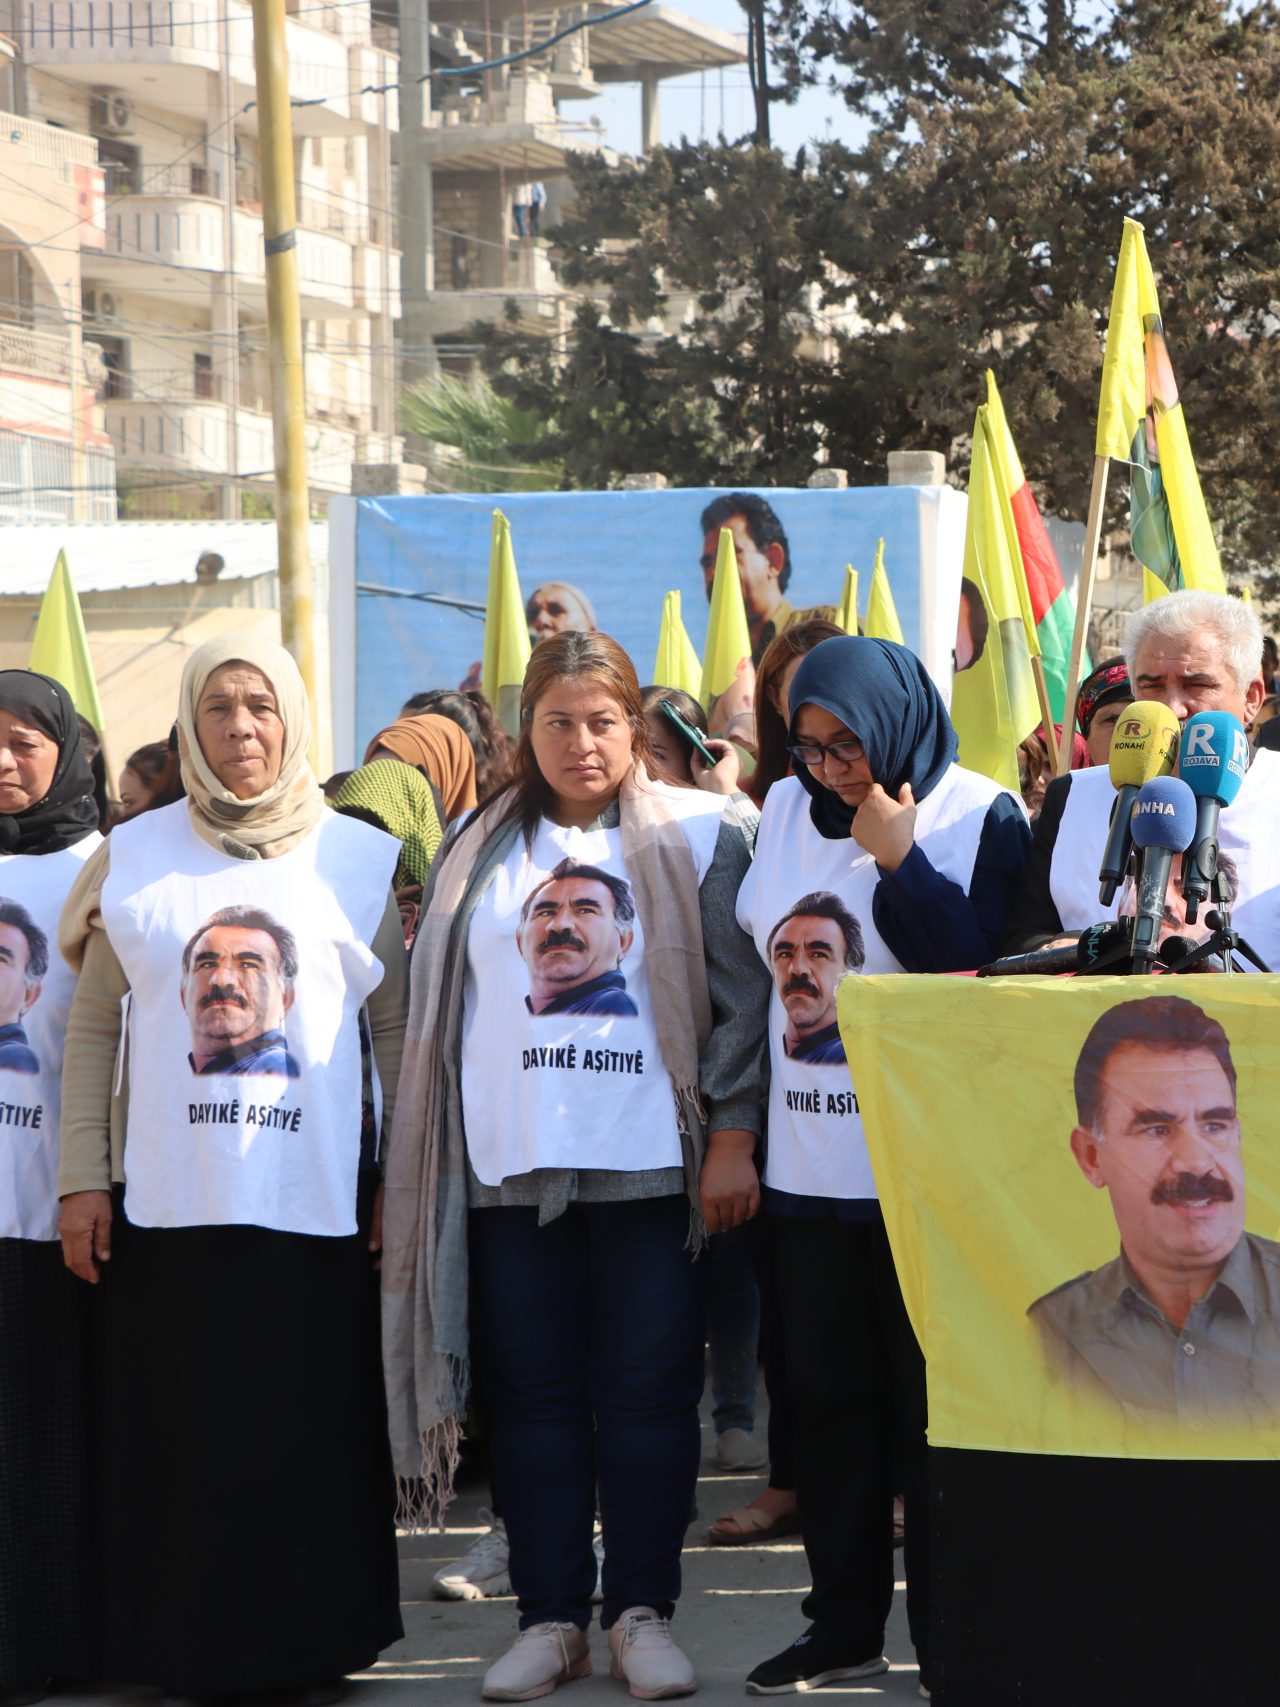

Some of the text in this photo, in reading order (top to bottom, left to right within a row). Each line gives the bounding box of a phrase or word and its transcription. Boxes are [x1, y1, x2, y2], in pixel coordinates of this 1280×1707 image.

[1187, 723, 1216, 755] R
[1183, 757, 1219, 766] ROJAVA
[522, 1044, 576, 1071] DAYIKÊ
[188, 1099, 239, 1124] DAYIKÊ
[783, 1088, 821, 1114] AYIKÊ
